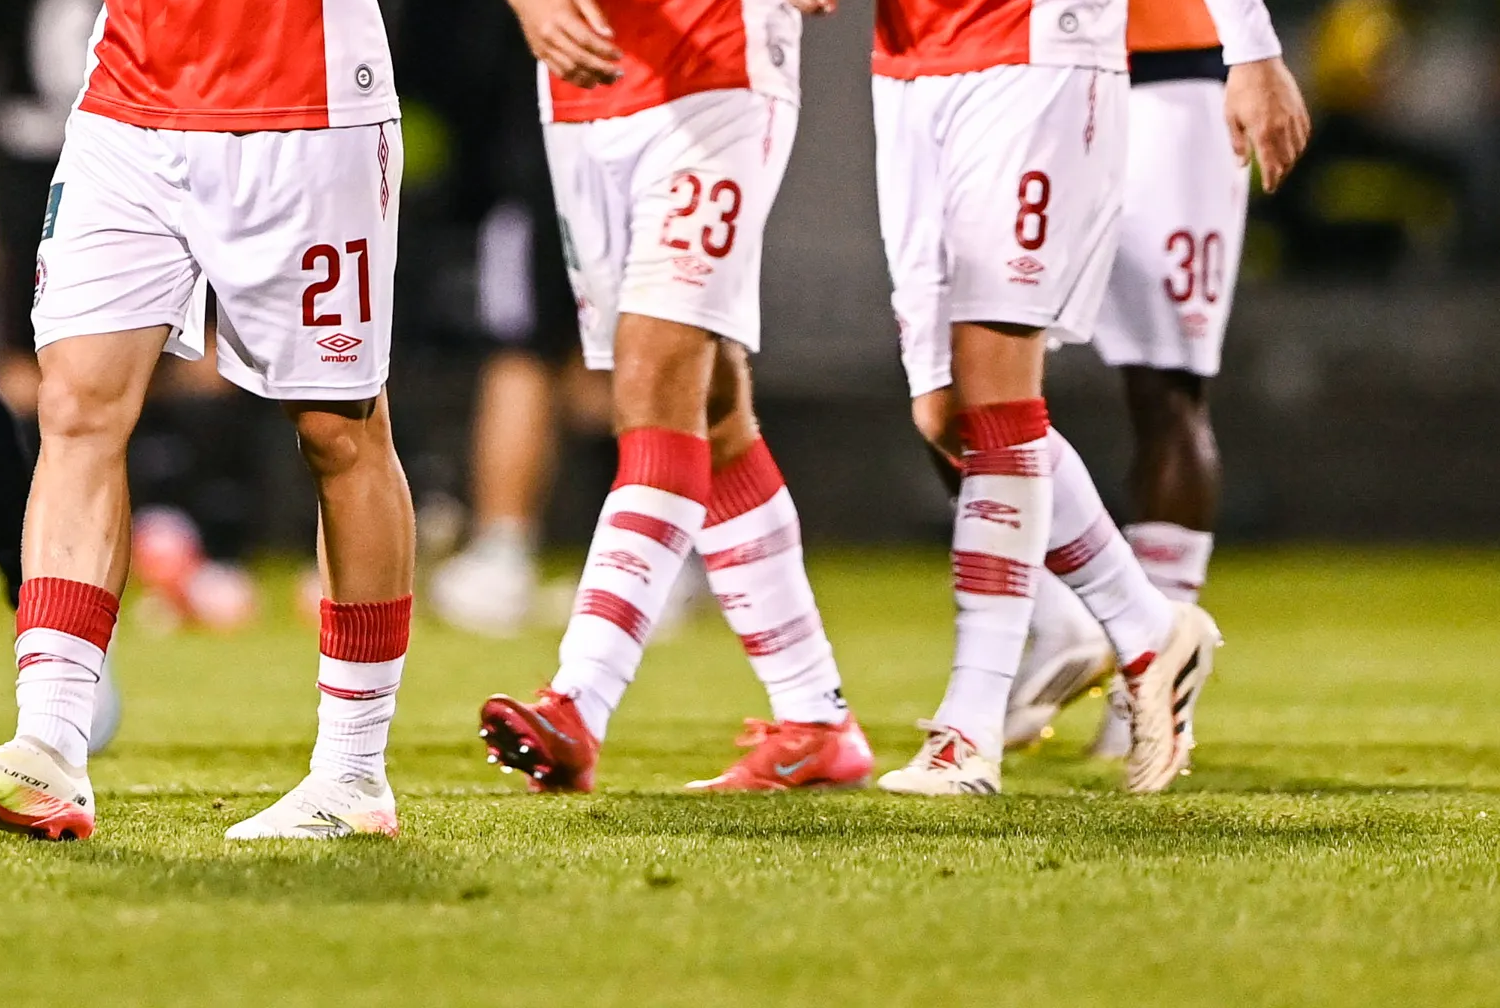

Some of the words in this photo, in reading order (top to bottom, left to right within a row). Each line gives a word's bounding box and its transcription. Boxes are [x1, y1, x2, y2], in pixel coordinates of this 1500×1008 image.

[660, 172, 742, 259] 23
[1015, 170, 1051, 250] 8
[301, 238, 371, 326] 21
[1163, 229, 1224, 303] 30
[321, 354, 357, 363] umbro
